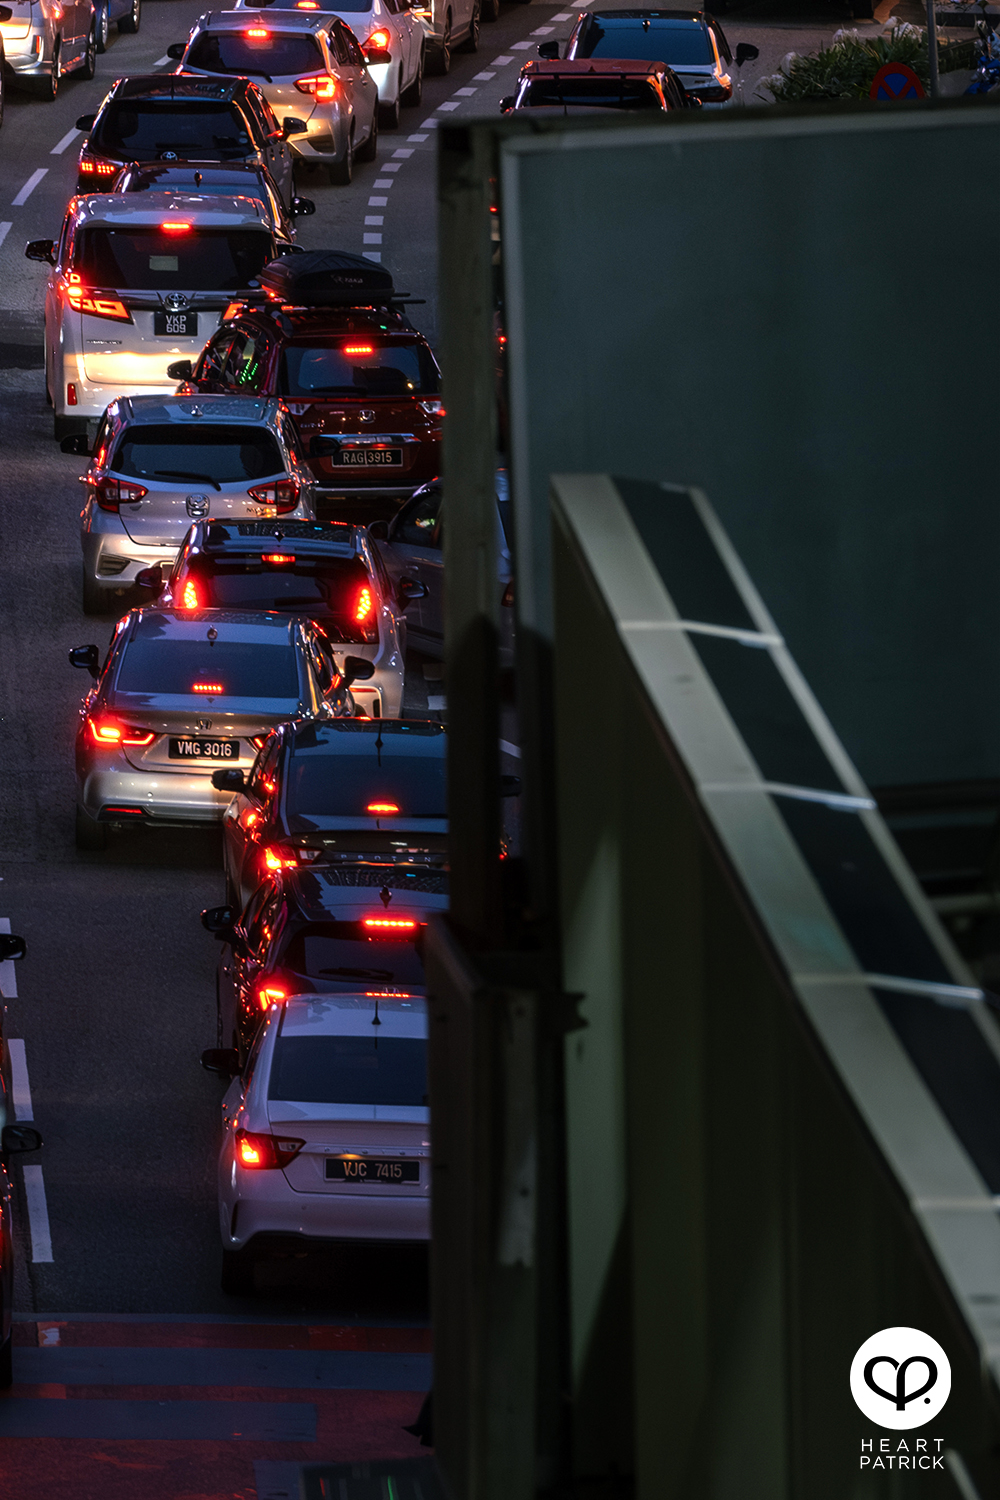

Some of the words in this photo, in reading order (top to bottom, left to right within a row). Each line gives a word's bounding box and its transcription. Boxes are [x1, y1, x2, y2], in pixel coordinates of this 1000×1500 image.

[165, 314, 188, 325] VKP
[165, 323, 187, 334] 609
[342, 451, 365, 464] RAG
[367, 451, 393, 464] 3915
[177, 740, 201, 756] VMG
[203, 741, 233, 757] 3016
[342, 1161, 368, 1177] VJC
[374, 1162, 403, 1178] 7415
